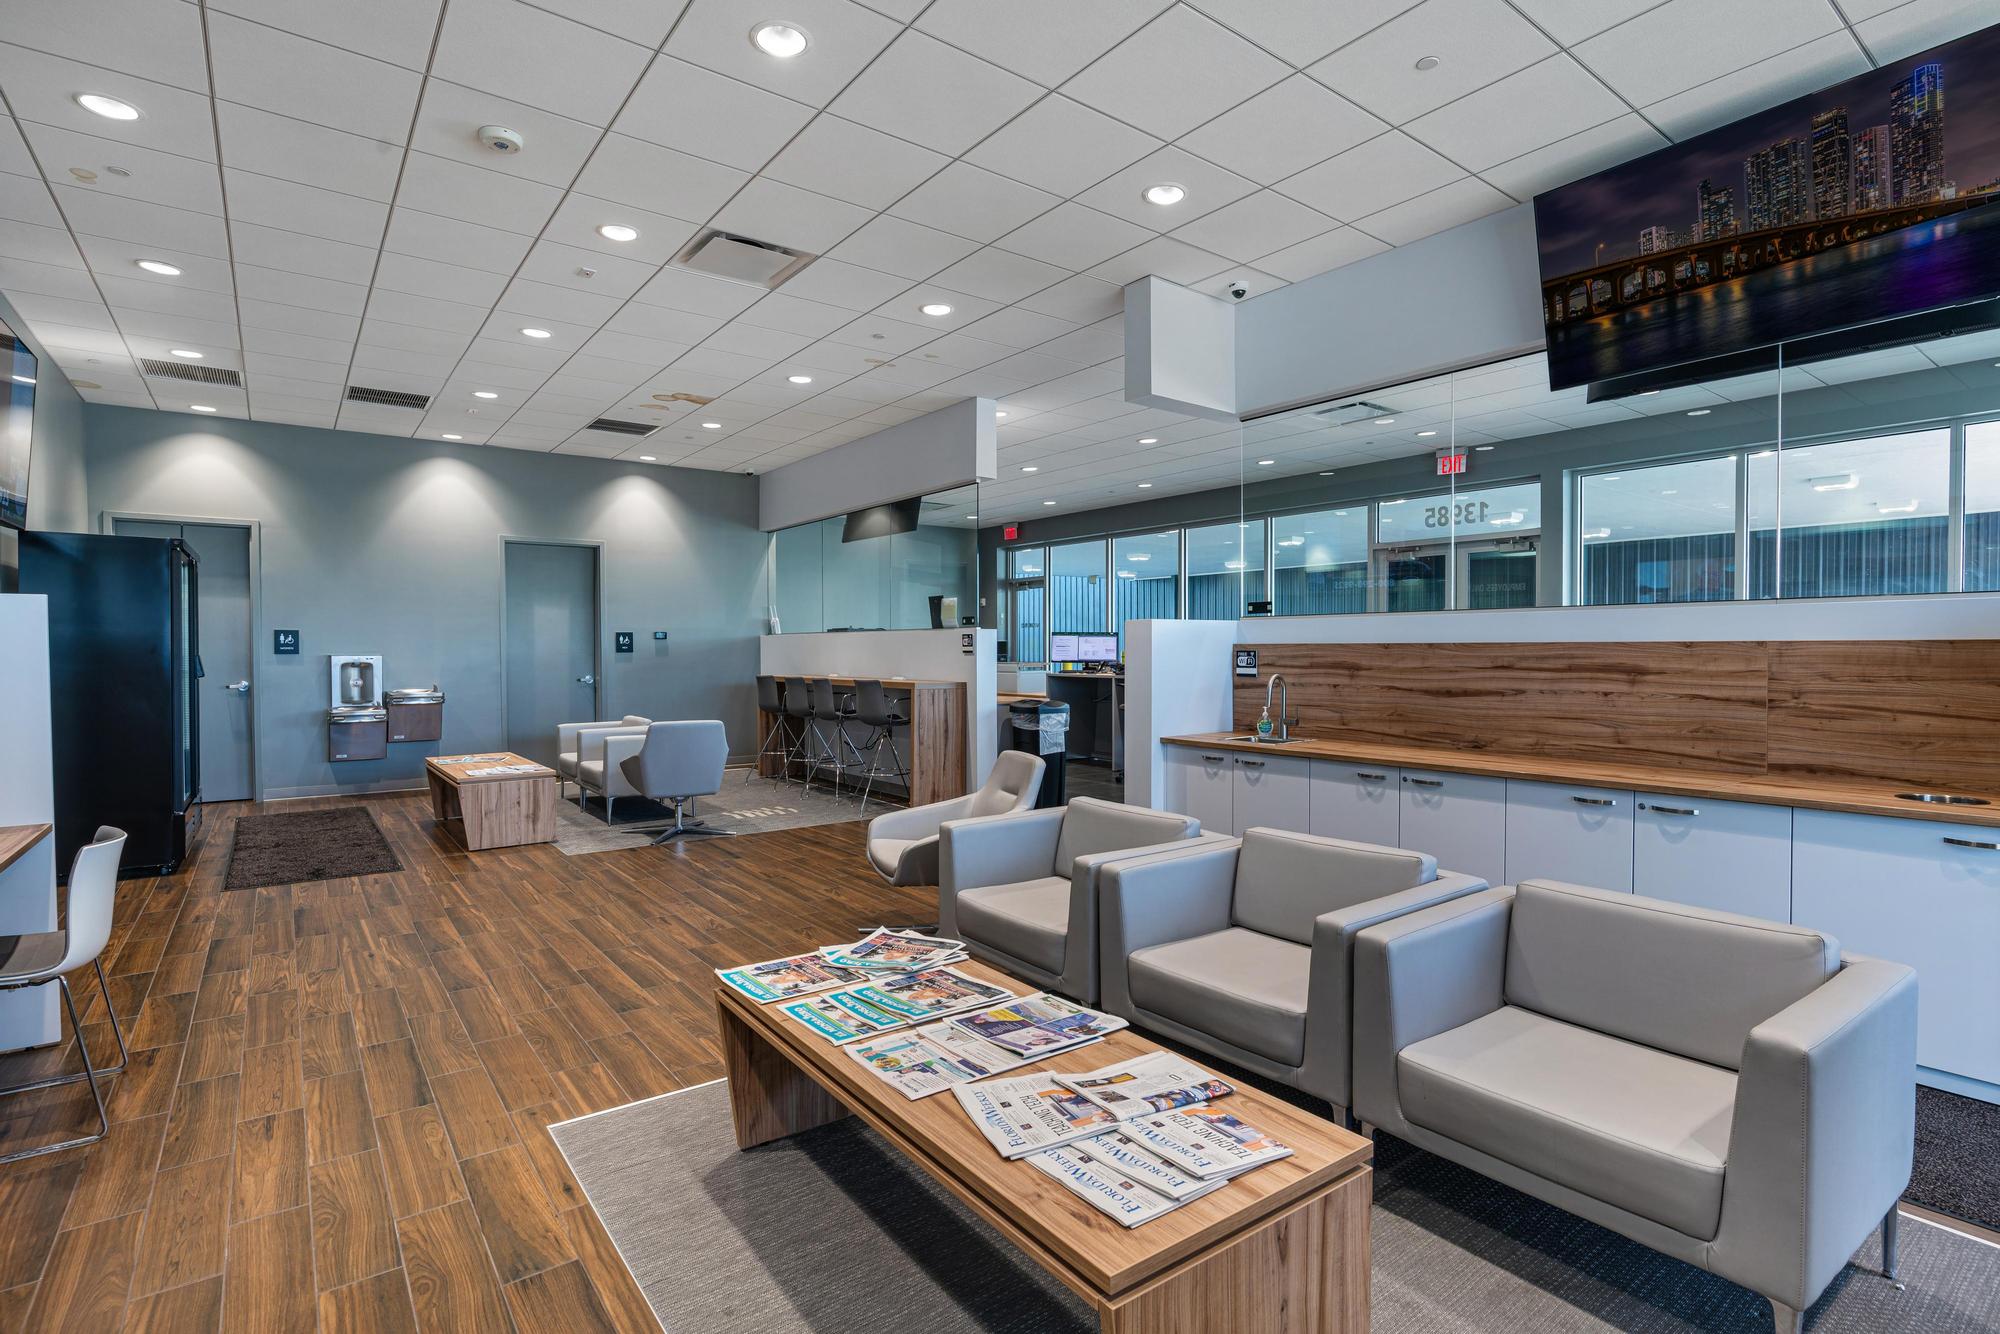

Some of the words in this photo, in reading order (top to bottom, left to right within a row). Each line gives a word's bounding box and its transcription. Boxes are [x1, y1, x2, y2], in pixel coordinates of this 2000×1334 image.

[1441, 454, 1463, 475] EXIT
[1019, 1094, 1044, 1111] TECH
[996, 1120, 1026, 1148] FLORIDA
[1033, 1108, 1074, 1137] TEACHING
[1128, 1117, 1160, 1141] WEEK
[1166, 1113, 1196, 1130] TECH
[1090, 1135, 1129, 1160] WEEK
[1160, 1136, 1212, 1168] FLORIDA
[1193, 1127, 1254, 1160] TEACHING
[1128, 1155, 1186, 1188] FLORIDA
[1087, 1175, 1142, 1214] FLORIDA
